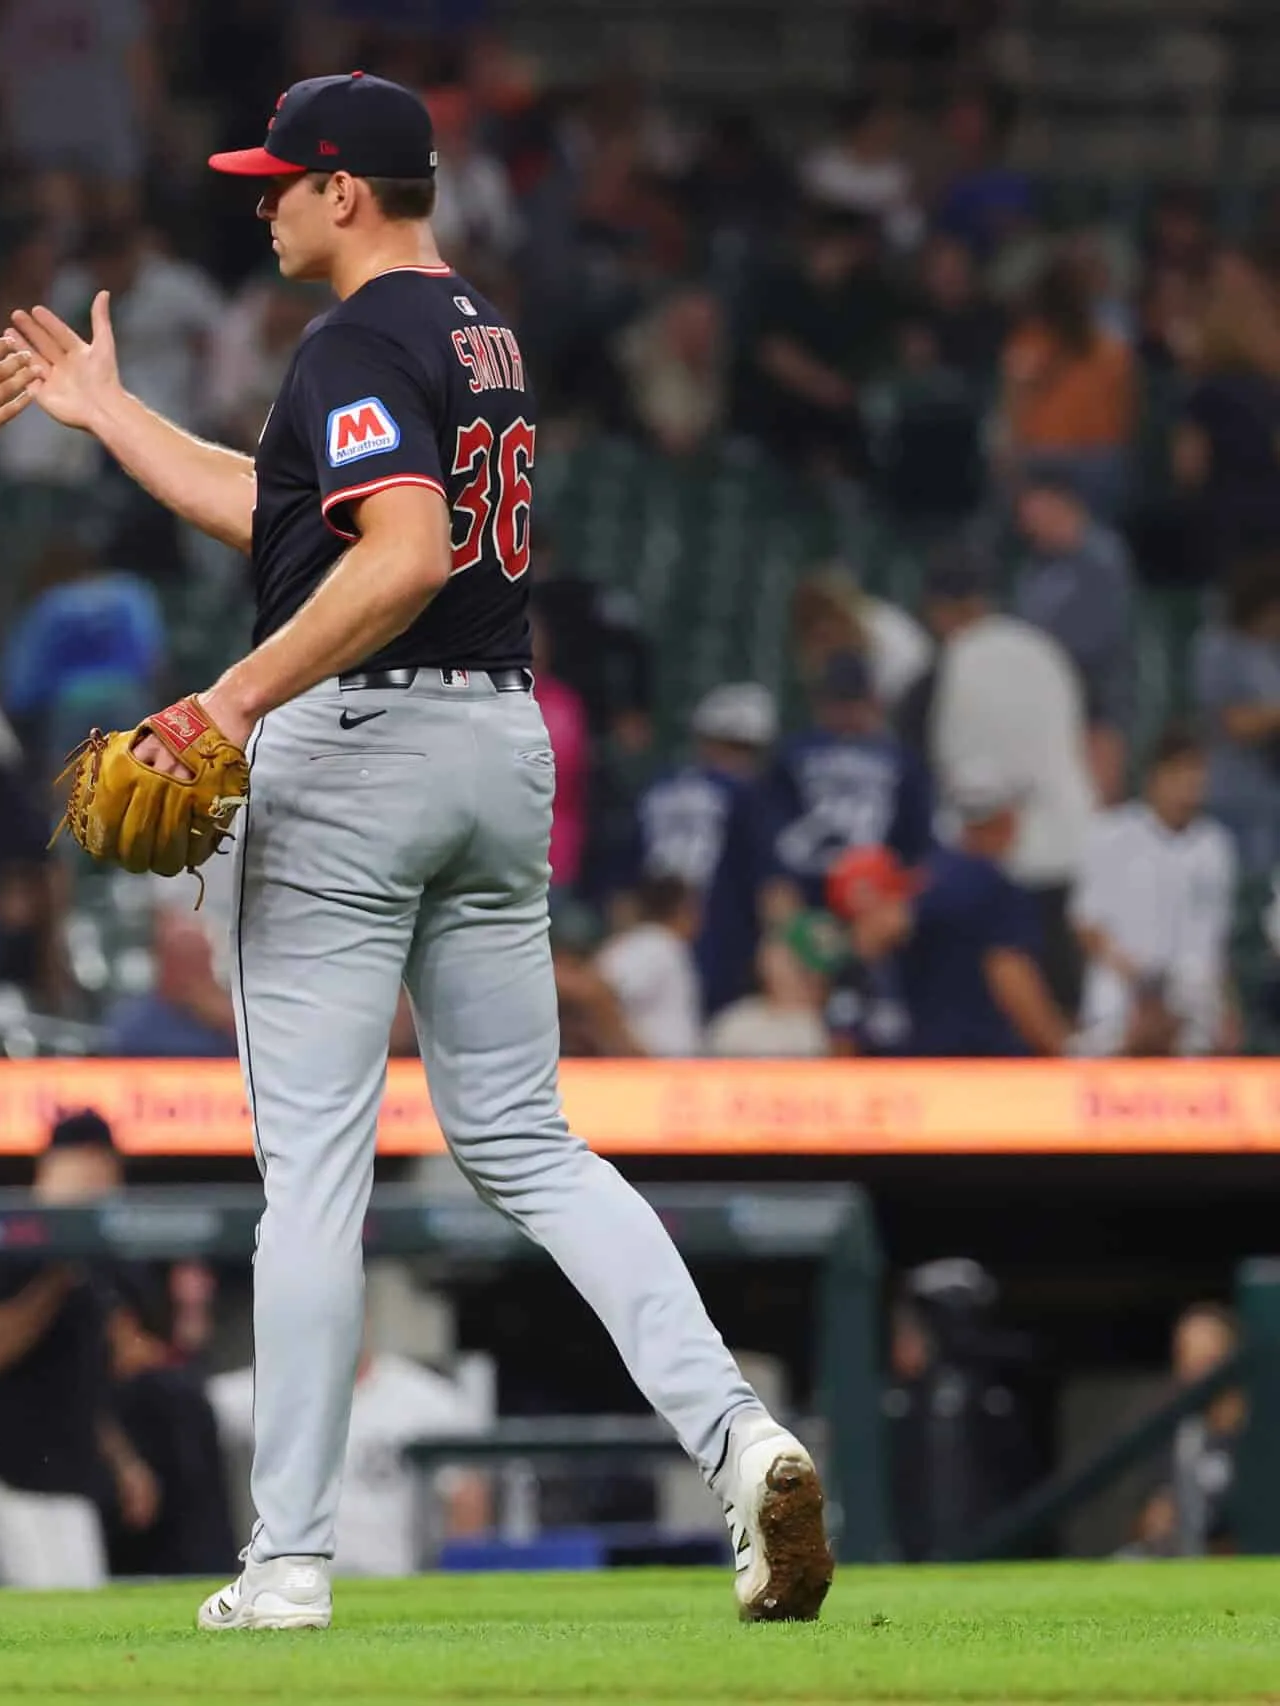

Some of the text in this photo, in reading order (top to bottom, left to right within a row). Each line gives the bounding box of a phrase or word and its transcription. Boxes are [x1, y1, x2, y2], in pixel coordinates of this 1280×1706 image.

[451, 325, 525, 393] SMITH
[336, 437, 391, 461] Marathon
[337, 407, 386, 449] M
[451, 416, 537, 583] 36
